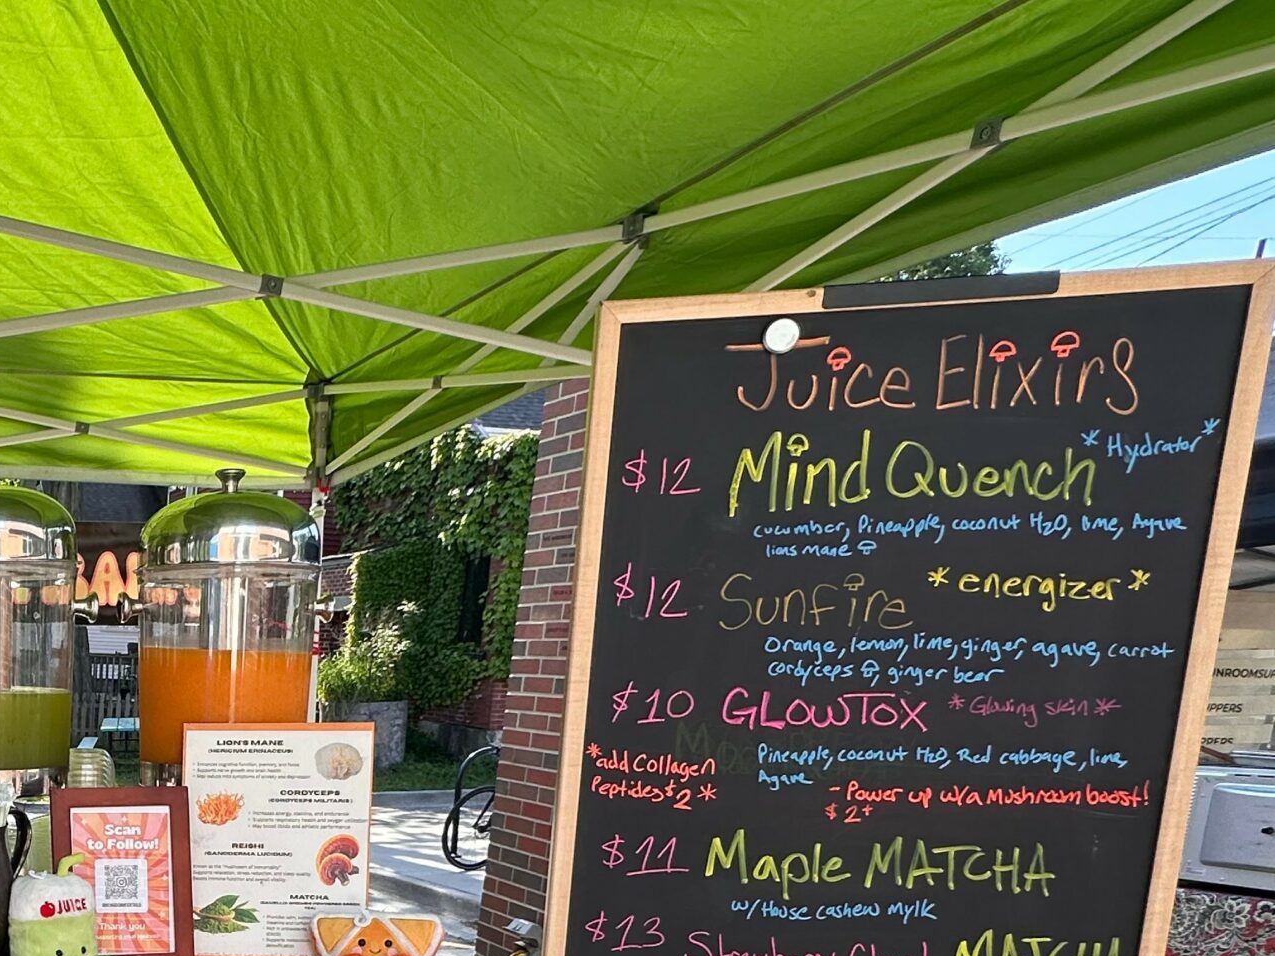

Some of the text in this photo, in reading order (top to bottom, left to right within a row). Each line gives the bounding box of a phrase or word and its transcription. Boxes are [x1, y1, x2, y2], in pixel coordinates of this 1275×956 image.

[725, 332, 1139, 415] Juice Elixirs
[622, 450, 700, 496] $12
[728, 429, 871, 518] Mind
[886, 434, 1099, 507] Quench
[952, 514, 1021, 530] coconut
[802, 544, 853, 557] mane
[614, 572, 688, 618] $12
[719, 572, 915, 631] Sunfire
[1108, 642, 1174, 658] carrot
[888, 665, 948, 686] ginger
[612, 681, 695, 724] $10
[837, 747, 908, 762] coconut
[956, 745, 991, 764] Red
[632, 753, 716, 782] Collagen
[757, 771, 813, 790] Agave
[846, 780, 904, 802] Power
[908, 787, 932, 808] up
[104, 824, 141, 836] Scan
[87, 838, 159, 850] to Follow!
[601, 828, 1057, 900] $11 Maple MATCHA
[57, 898, 88, 915] JUICE
[816, 902, 880, 919] cashew
[128, 922, 146, 932] you
[584, 911, 665, 951] $13
